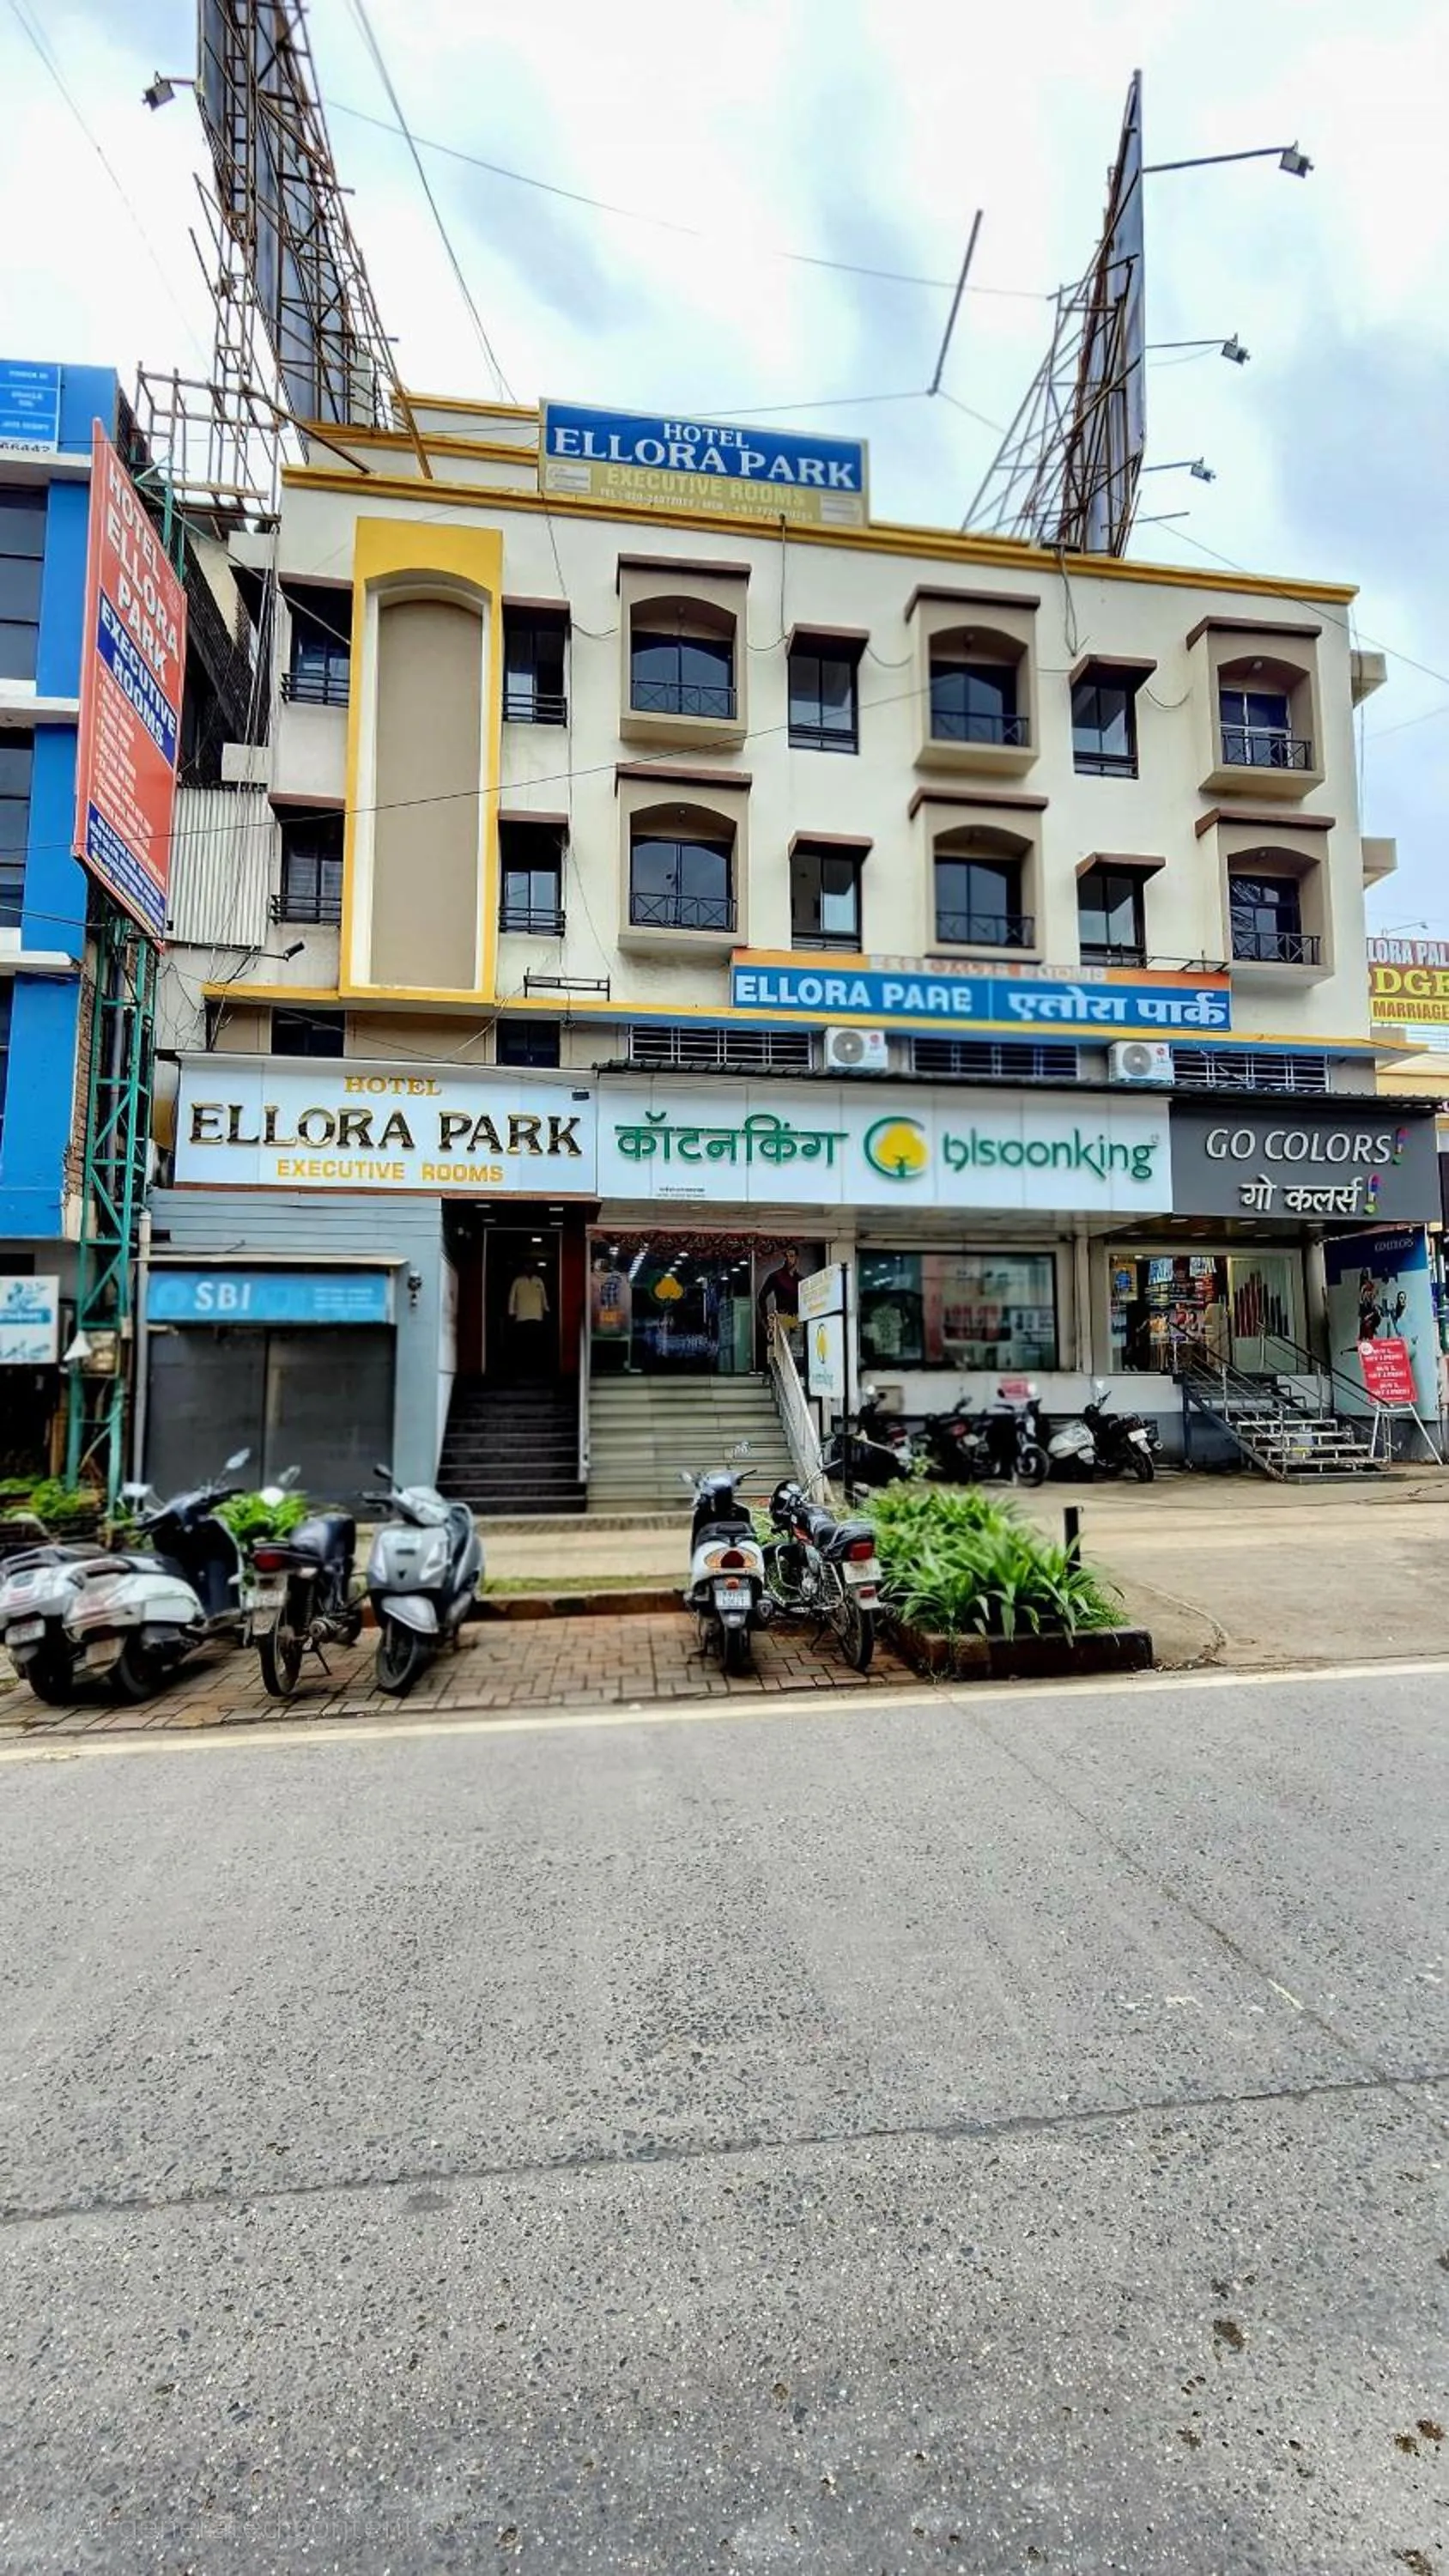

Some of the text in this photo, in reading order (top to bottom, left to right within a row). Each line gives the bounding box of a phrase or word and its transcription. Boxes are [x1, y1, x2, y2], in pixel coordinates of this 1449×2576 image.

[664, 422, 749, 450] HOTEL
[554, 426, 856, 489] ELLORA PARK
[606, 466, 722, 498] EXECUTIVE
[730, 482, 805, 507] ROOMS
[109, 458, 161, 584] HOTEL
[107, 501, 179, 663] ELLORA
[118, 572, 168, 686] PARK
[100, 596, 177, 738] EXECUTIVE
[112, 652, 165, 748] ROOMS
[736, 975, 871, 1007] ELLORA
[1368, 967, 1449, 997] DGE
[1137, 992, 1227, 1025] पार्क
[343, 1076, 442, 1097] HOTEL
[189, 1102, 584, 1157] ELLORA PARK
[1206, 1128, 1256, 1160] GO
[277, 1159, 504, 1182] EXECUTIVE ROOMS
[1239, 1174, 1277, 1211] गो
[193, 1280, 252, 1311] SBI
